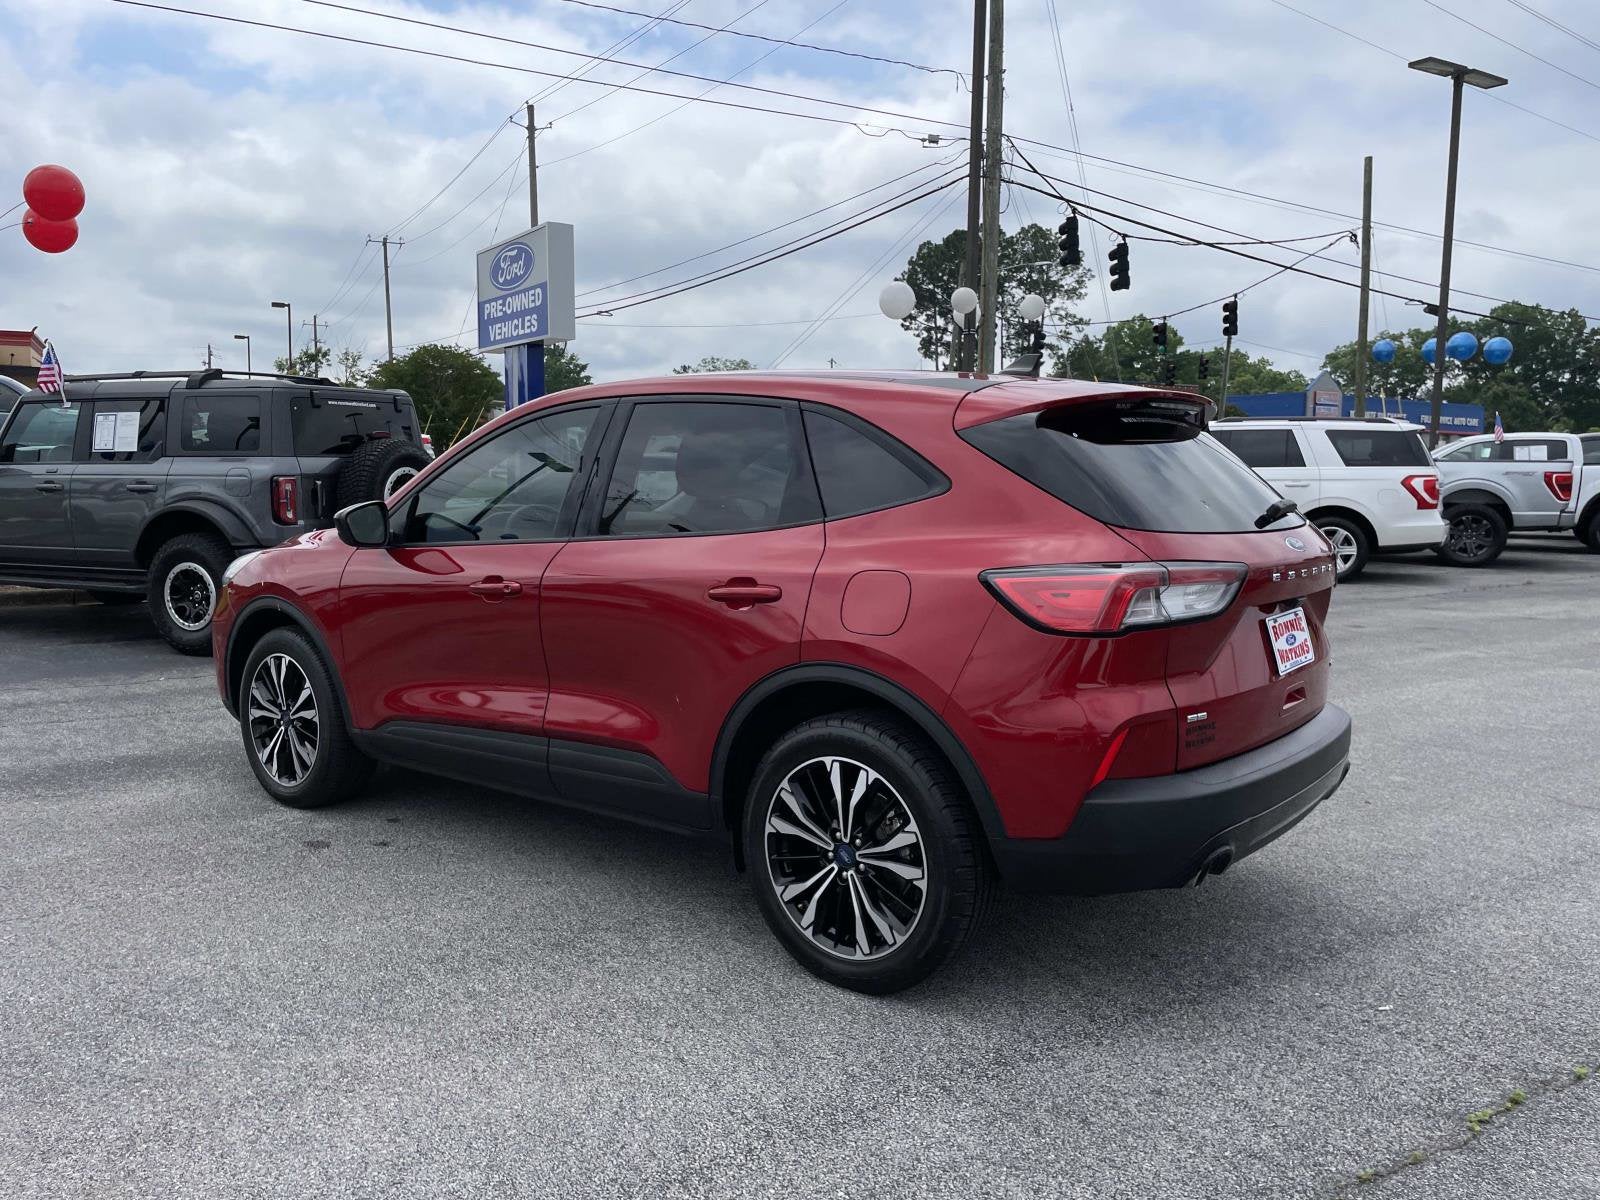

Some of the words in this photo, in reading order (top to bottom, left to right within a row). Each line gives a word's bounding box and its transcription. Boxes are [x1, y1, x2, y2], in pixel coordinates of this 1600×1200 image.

[498, 249, 526, 284] Ford
[484, 287, 543, 321] PRE-OWNED
[488, 313, 538, 342] VEHICLES
[1271, 616, 1306, 642] RONNIE
[1277, 638, 1310, 665] WATKINS
